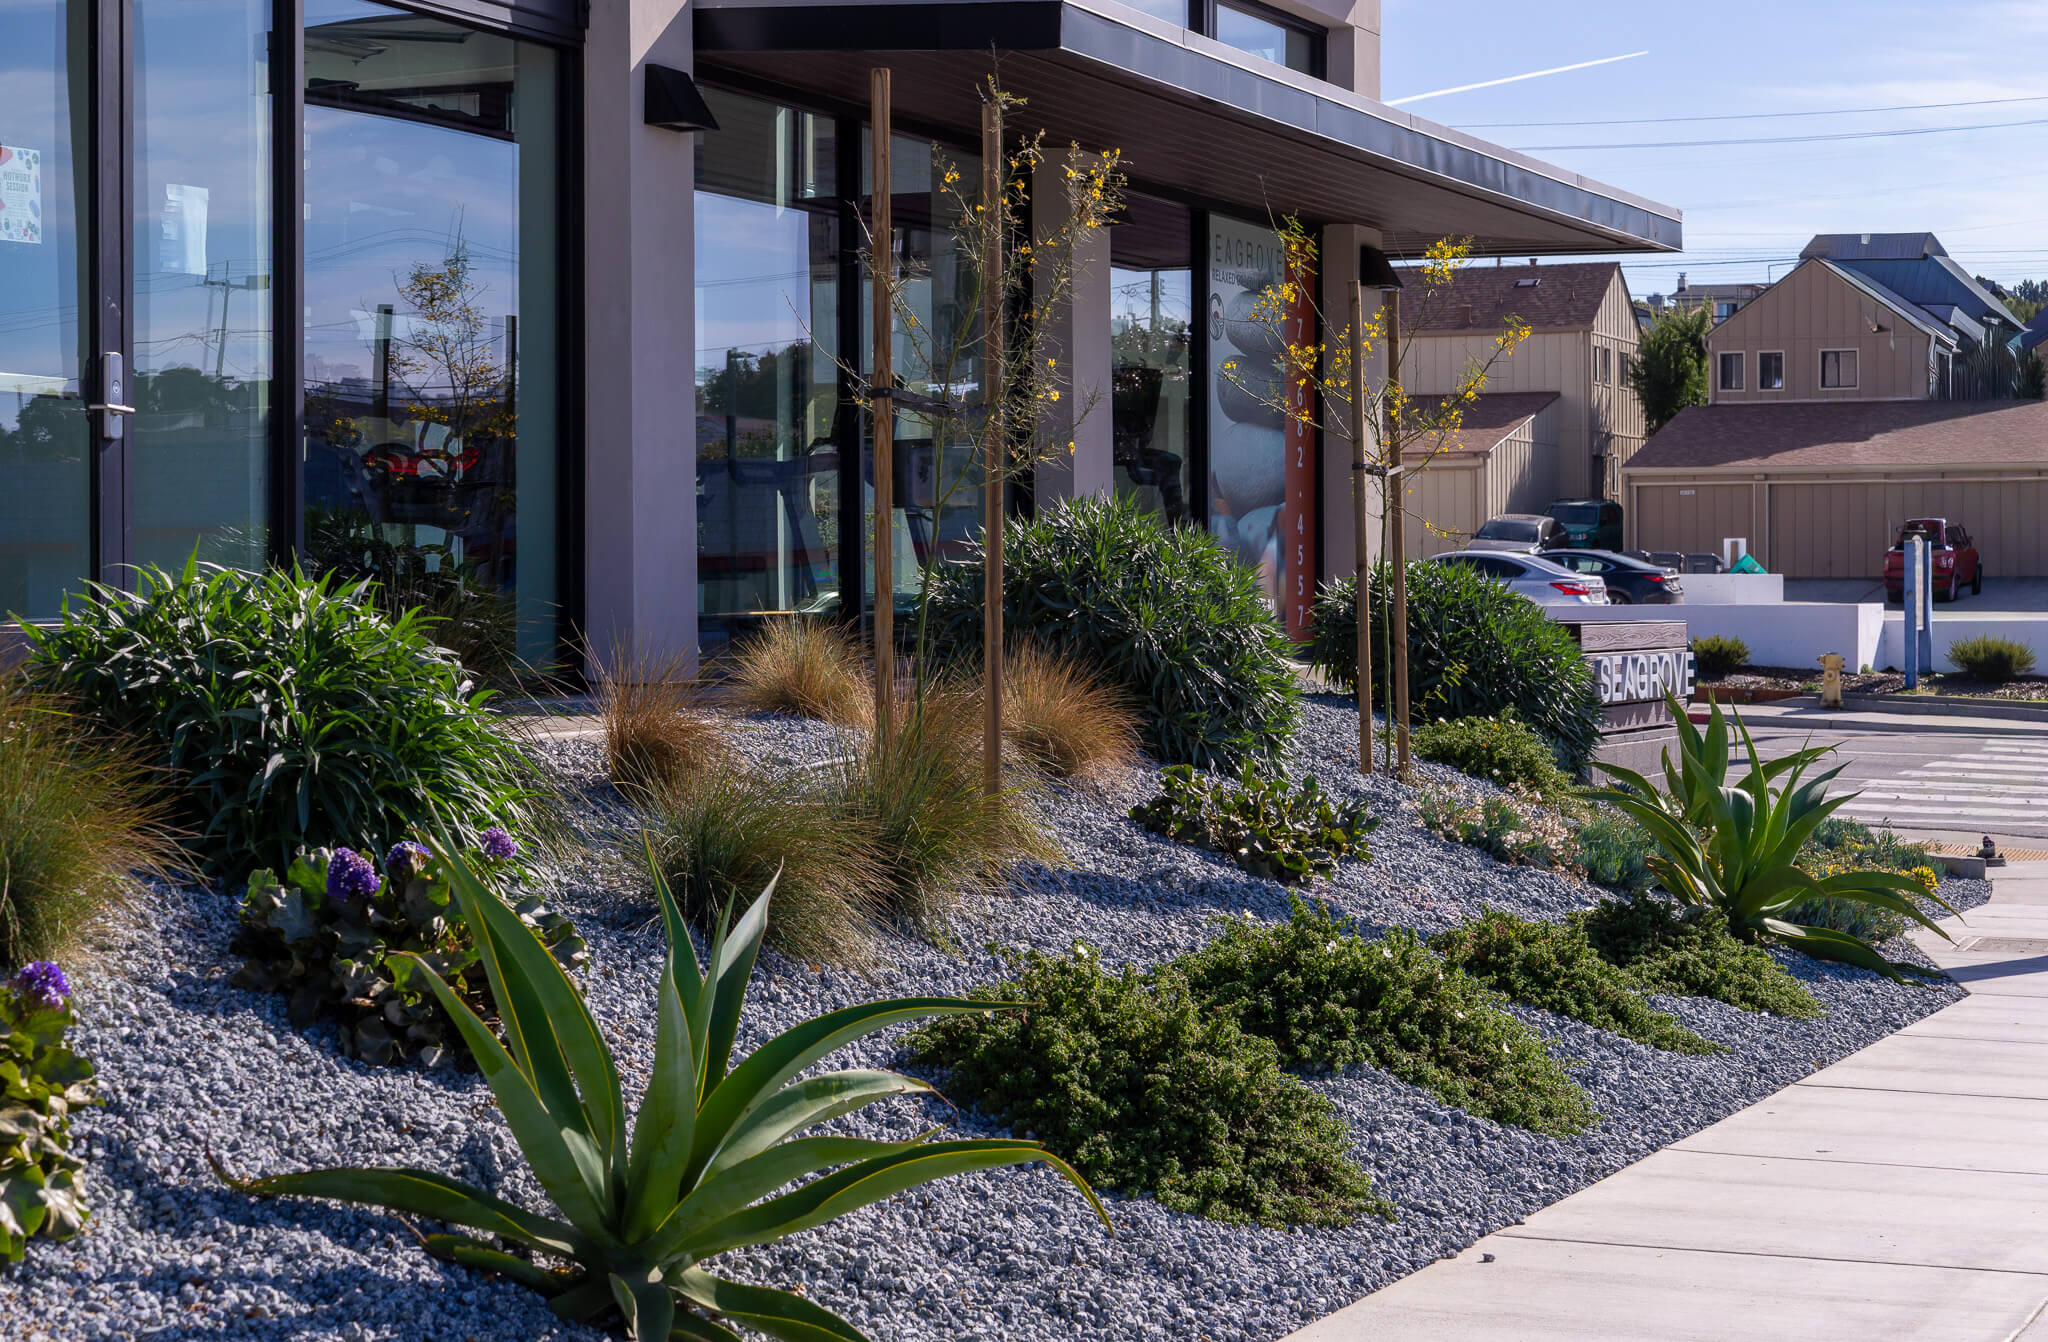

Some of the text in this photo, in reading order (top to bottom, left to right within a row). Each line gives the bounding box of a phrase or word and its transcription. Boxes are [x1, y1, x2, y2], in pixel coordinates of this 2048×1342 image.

[1211, 268, 1236, 285] RELAXED
[1215, 233, 1283, 277] EAGROVE
[1600, 651, 1695, 703] SEAGROVE
